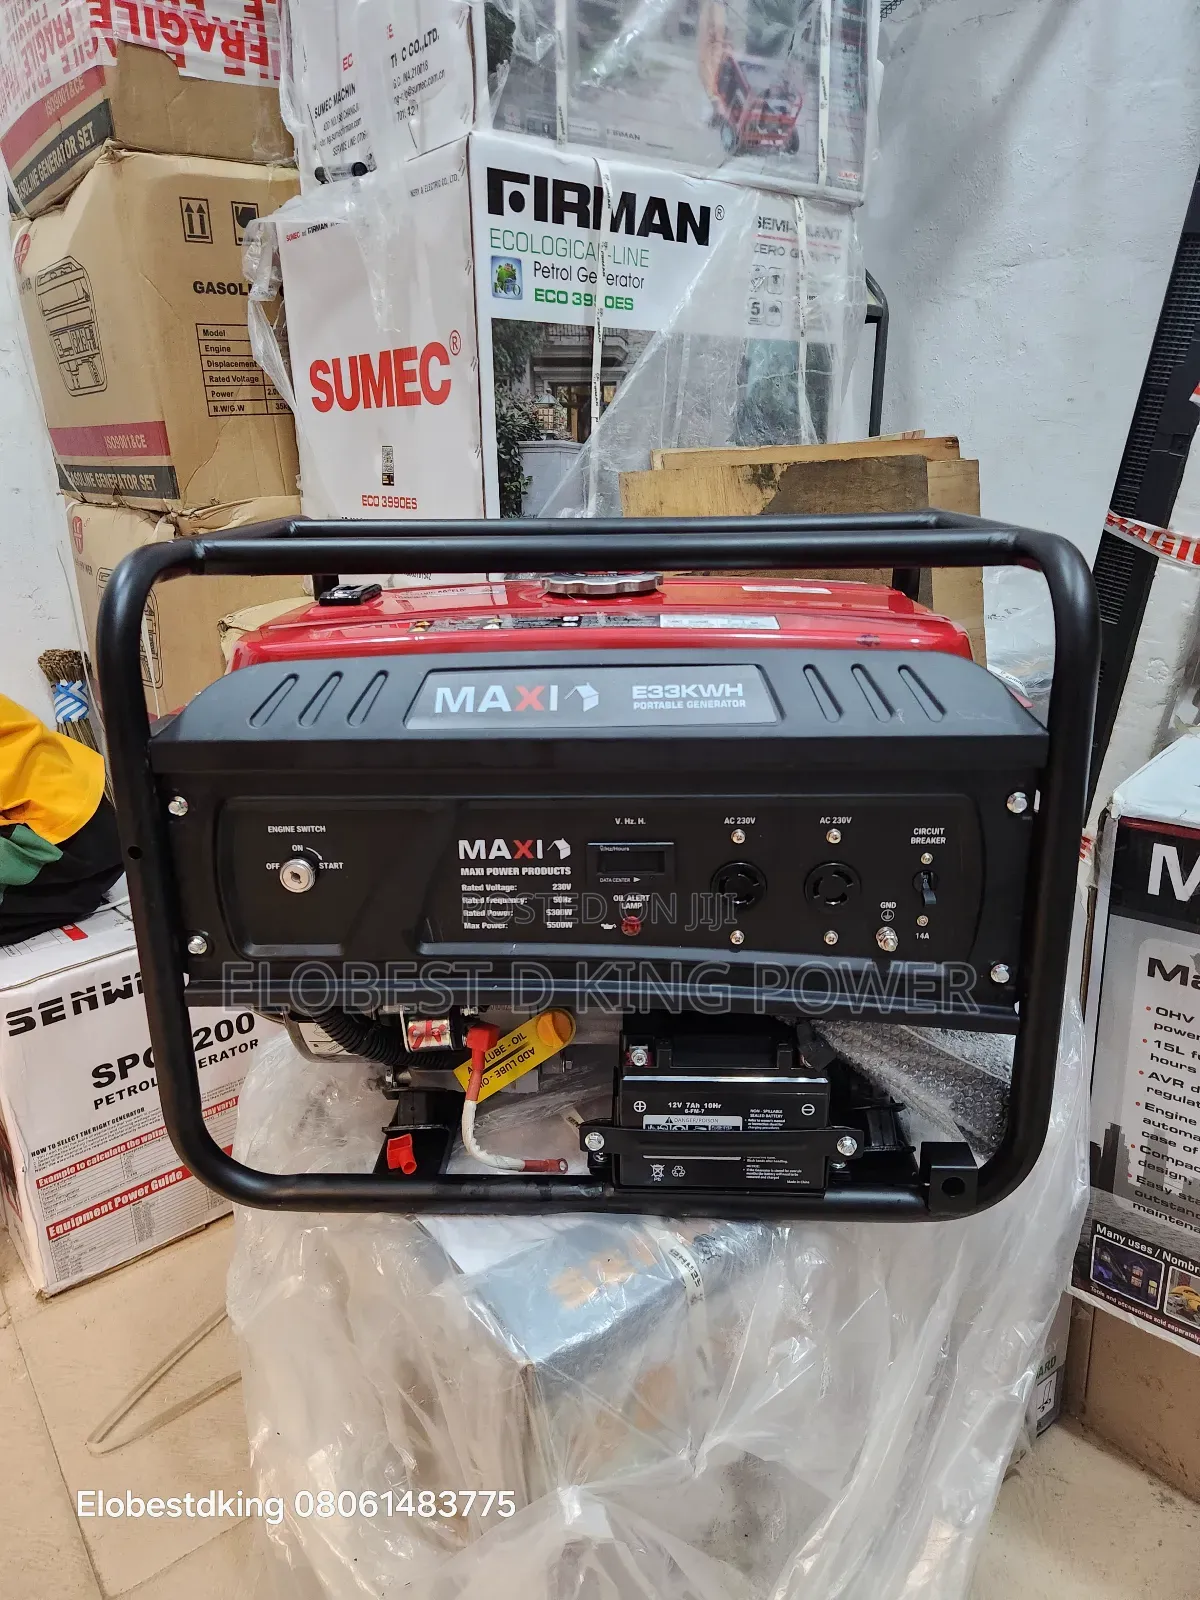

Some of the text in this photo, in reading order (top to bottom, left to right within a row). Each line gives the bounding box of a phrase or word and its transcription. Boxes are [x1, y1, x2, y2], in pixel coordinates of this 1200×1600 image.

[21, 8, 75, 80] FRAGILE
[38, 121, 95, 181] GENERATOR SET
[487, 167, 711, 246] FIRMAN
[533, 261, 645, 290] Petrol Geerator
[534, 288, 569, 306] ECO
[202, 329, 226, 337] Model
[204, 345, 231, 354] Engine
[206, 360, 257, 369] Displacement
[209, 375, 259, 384] Rated Voltage
[309, 341, 452, 413] SUMEC
[211, 390, 234, 398] Power
[213, 404, 245, 413] N.W/G.W
[94, 472, 141, 491] GENERATOR
[139, 474, 157, 491] SET
[362, 495, 418, 510] ECO 3990ES
[435, 685, 559, 714] MAXI
[632, 683, 744, 700] E33KWH
[633, 699, 746, 710] PORTABLE GENERATOR
[267, 825, 326, 833] ENGINE SWITCH
[625, 817, 640, 825] Hz.
[724, 817, 756, 825] AC 230V
[820, 817, 852, 825] AC 230V
[913, 828, 945, 836] CIRCUIT
[292, 844, 303, 852] ON
[458, 838, 543, 860] MAXI
[910, 837, 947, 845] BREAKER
[266, 862, 344, 870] OFF START
[461, 866, 572, 876] MAXI POWER PRODUCTS
[461, 883, 572, 893] Rated Voltage: 230V
[462, 896, 485, 904] Rated
[552, 896, 572, 904] 50Hz
[613, 894, 650, 902] OIL ALERT
[621, 902, 643, 910] LAMP
[880, 901, 897, 909] GND
[463, 909, 485, 917] Rated
[486, 909, 514, 918] Power:
[464, 922, 480, 930] Max
[482, 922, 508, 930] Power:
[915, 932, 930, 940] 14A
[1156, 1007, 1195, 1024] OHV
[484, 1032, 526, 1064] LUBE OIL
[517, 1046, 536, 1064] ADD
[1153, 1039, 1186, 1056] 15L
[496, 1057, 518, 1079] LUBE
[1150, 1053, 1197, 1074] hours
[1148, 1071, 1185, 1088] AVR
[93, 1077, 159, 1111] PETROL
[667, 1101, 683, 1109] 12V
[685, 1101, 701, 1109] 7Ah
[1144, 1102, 1197, 1126] Engine
[31, 1146, 47, 1158] HOW
[47, 1143, 56, 1151] TO
[56, 1132, 79, 1148] SELECT
[79, 1127, 92, 1138] THE
[92, 1120, 111, 1133] RIGHT
[111, 1106, 145, 1125] GENERATOR
[1141, 1131, 1199, 1155] case of
[38, 1165, 76, 1187] Example
[76, 1159, 86, 1169] to
[86, 1143, 127, 1166] calculate
[126, 1137, 141, 1150] the
[1138, 1160, 1193, 1186] design,
[1136, 1175, 1173, 1195] Easy
[49, 1197, 113, 1238] Equipment
[115, 1184, 150, 1208] Power
[150, 1168, 184, 1192] Guide
[1096, 1223, 1126, 1249] Many
[1127, 1238, 1153, 1257] uses
[1090, 1285, 1167, 1326] Tools and accessories sold
